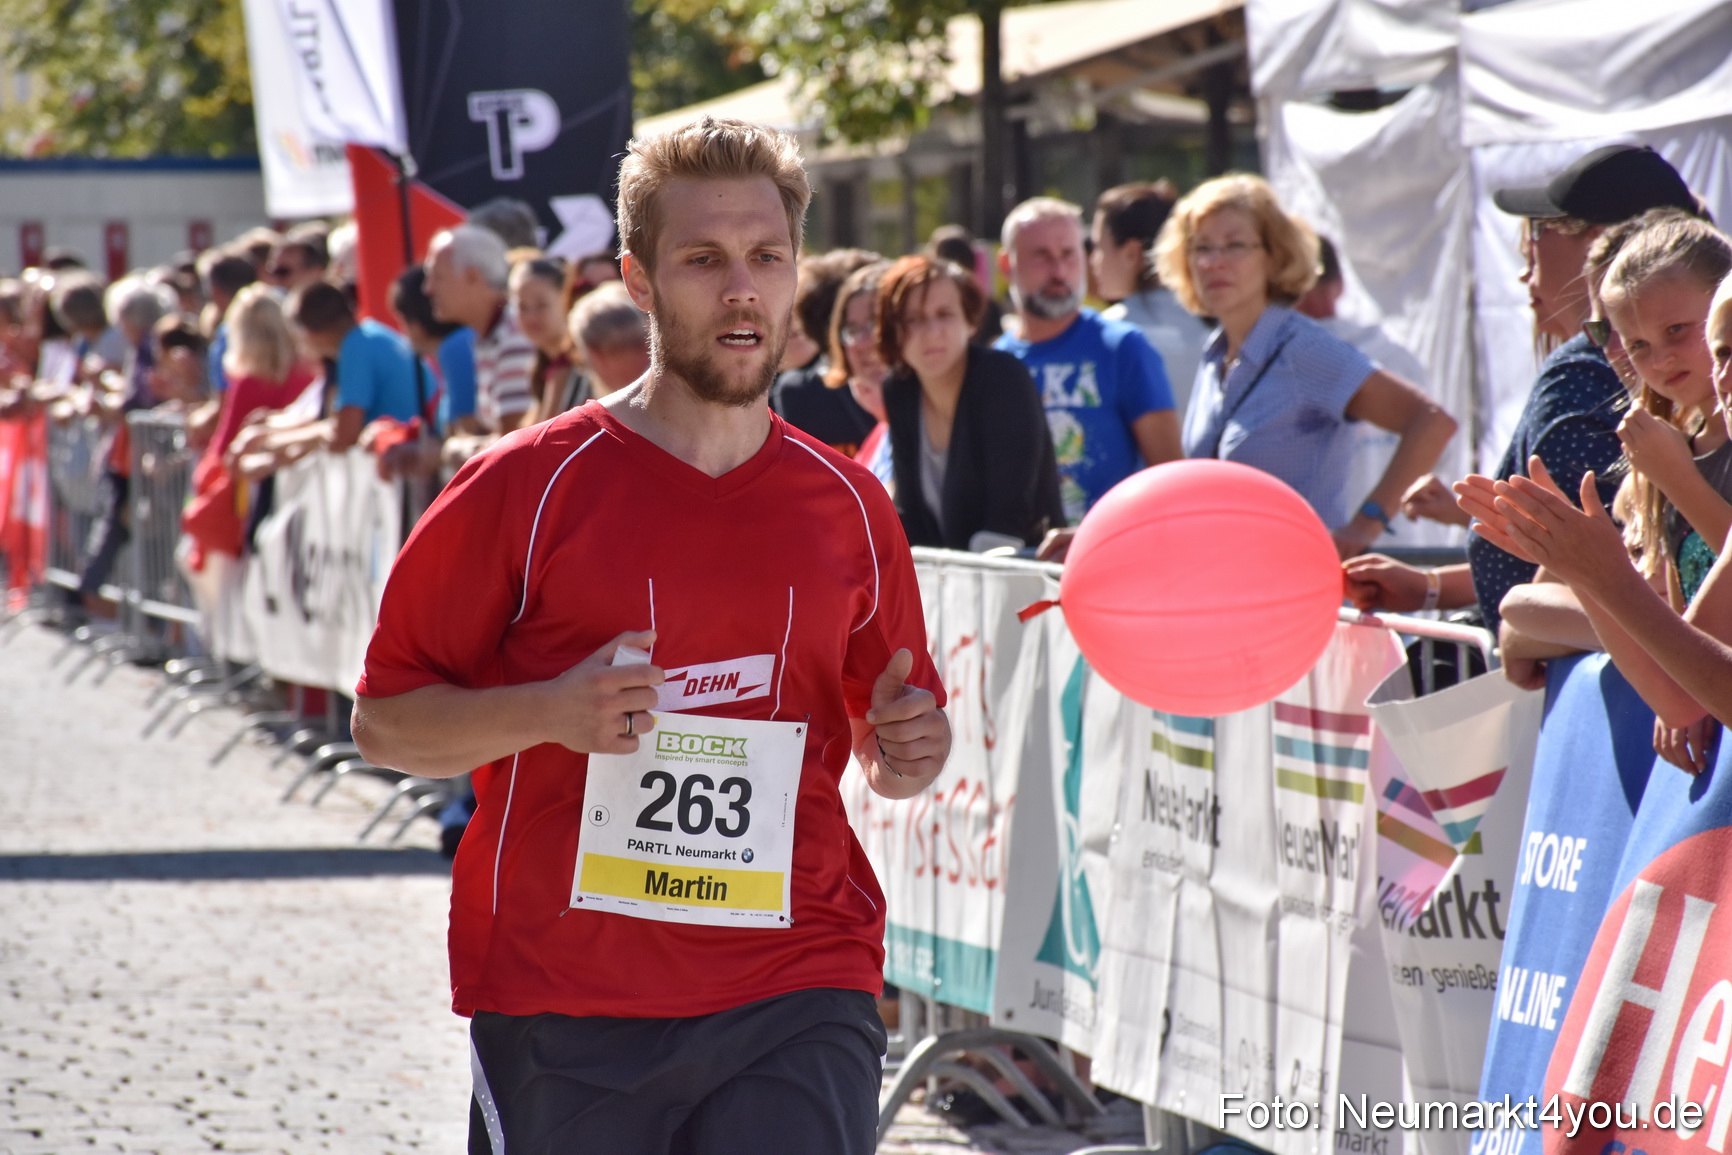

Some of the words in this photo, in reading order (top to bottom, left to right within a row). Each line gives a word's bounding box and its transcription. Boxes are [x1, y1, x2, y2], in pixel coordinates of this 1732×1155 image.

[683, 671, 741, 697] DEHN
[656, 731, 748, 759] BOCK
[655, 752, 684, 762] inspired
[685, 754, 694, 763] by
[695, 756, 715, 764] smart
[717, 759, 748, 767] concepts
[594, 810, 603, 822] B
[635, 770, 753, 838] 263
[627, 838, 672, 856] PARTL
[675, 845, 737, 861] Neumarkt
[1520, 831, 1588, 893] STORE
[644, 870, 728, 902] Martin
[1562, 878, 1732, 1155] He
